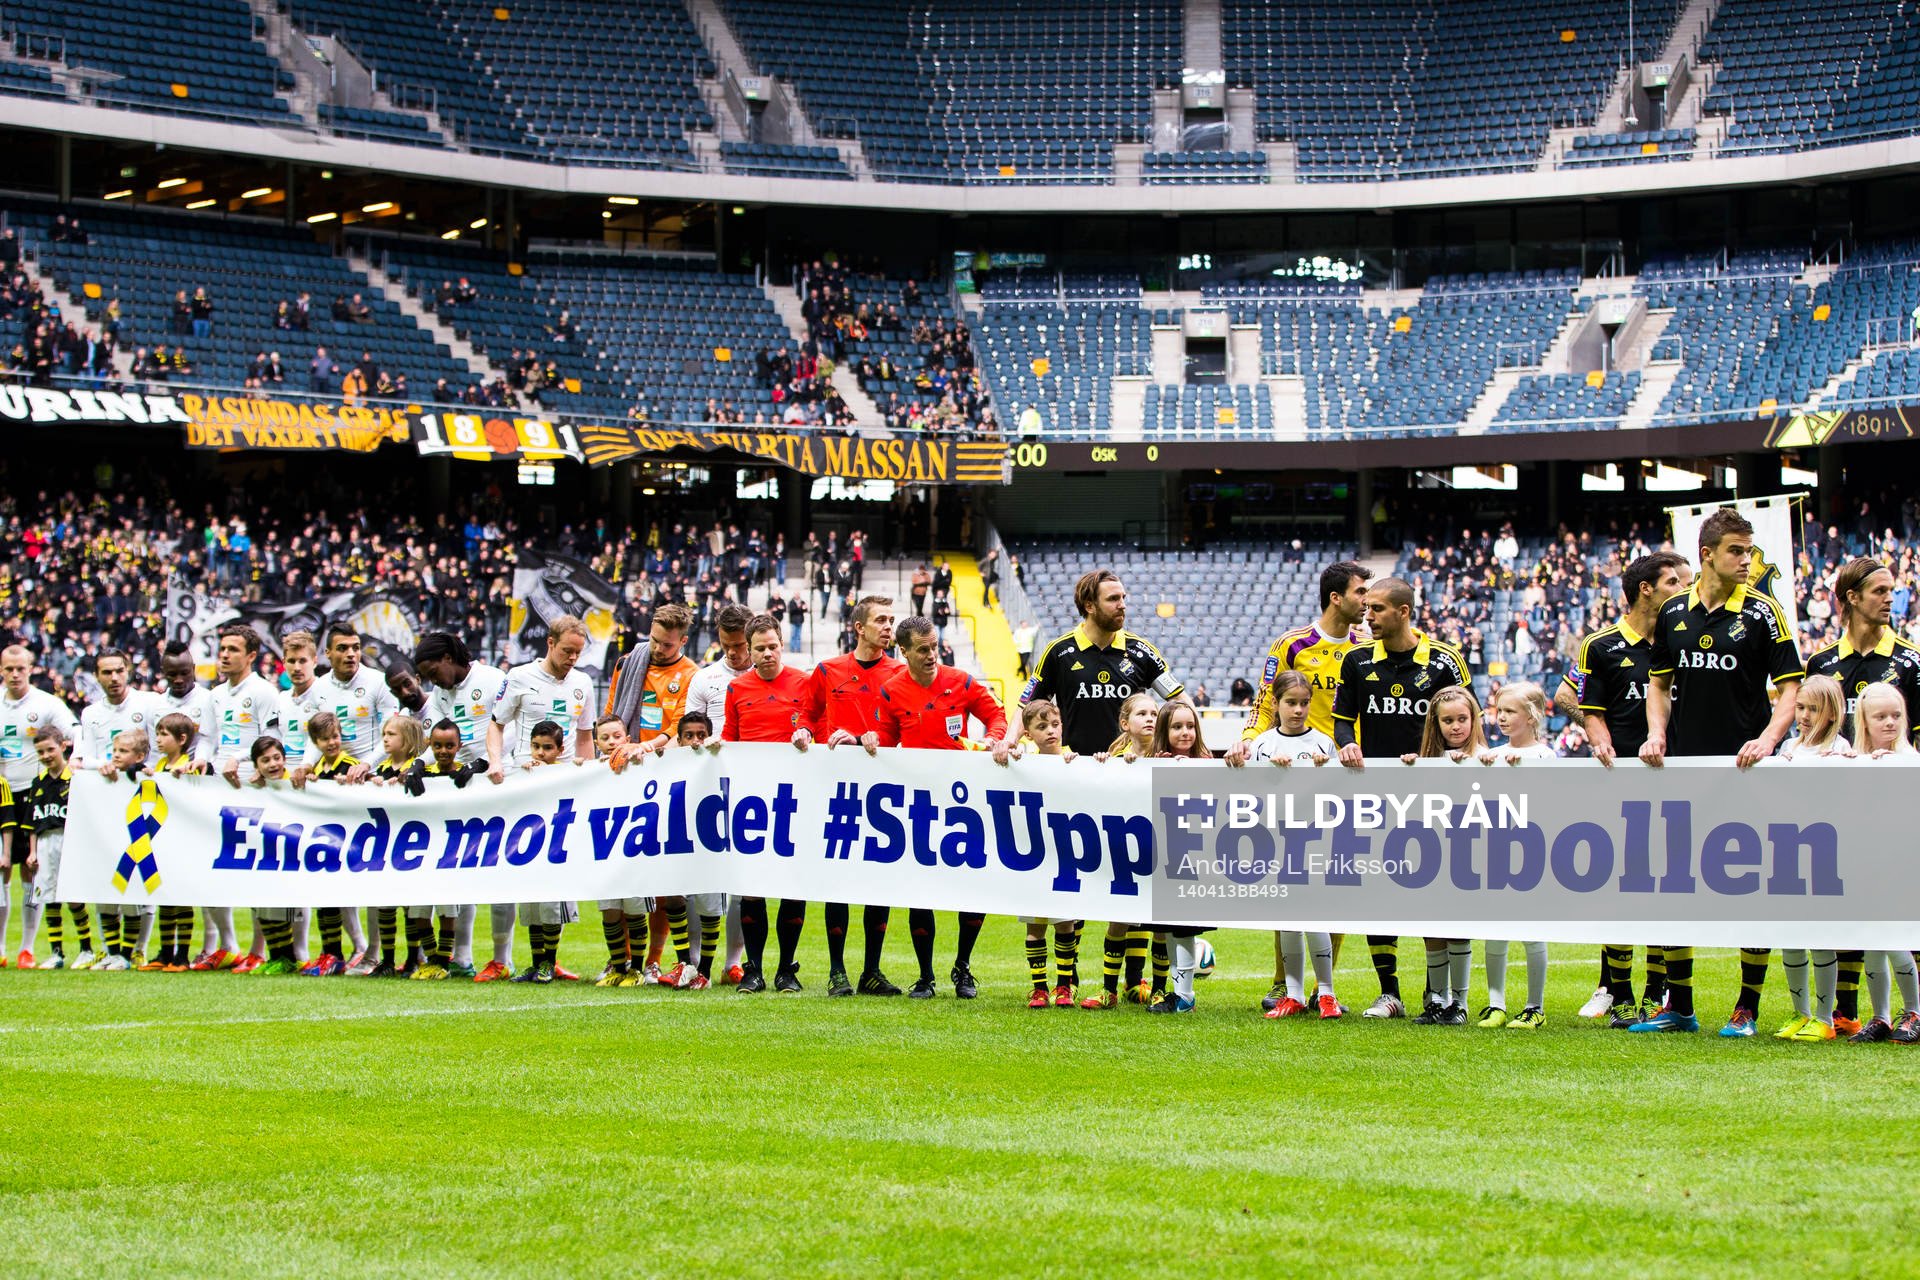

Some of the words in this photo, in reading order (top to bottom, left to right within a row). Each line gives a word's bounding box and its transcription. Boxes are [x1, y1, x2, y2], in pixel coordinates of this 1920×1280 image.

[187, 422, 234, 446] DET
[823, 436, 949, 480] MASSAN
[1091, 447, 1118, 462] ÖSK
[1146, 445, 1159, 462] 0
[1678, 649, 1738, 671] ÅBRO
[1076, 682, 1132, 699] ÅBRO
[1367, 694, 1431, 716] ÅBRO
[948, 723, 961, 731] FIFA
[212, 806, 430, 873] Enade
[436, 798, 576, 870] mot
[588, 777, 798, 861] våldet
